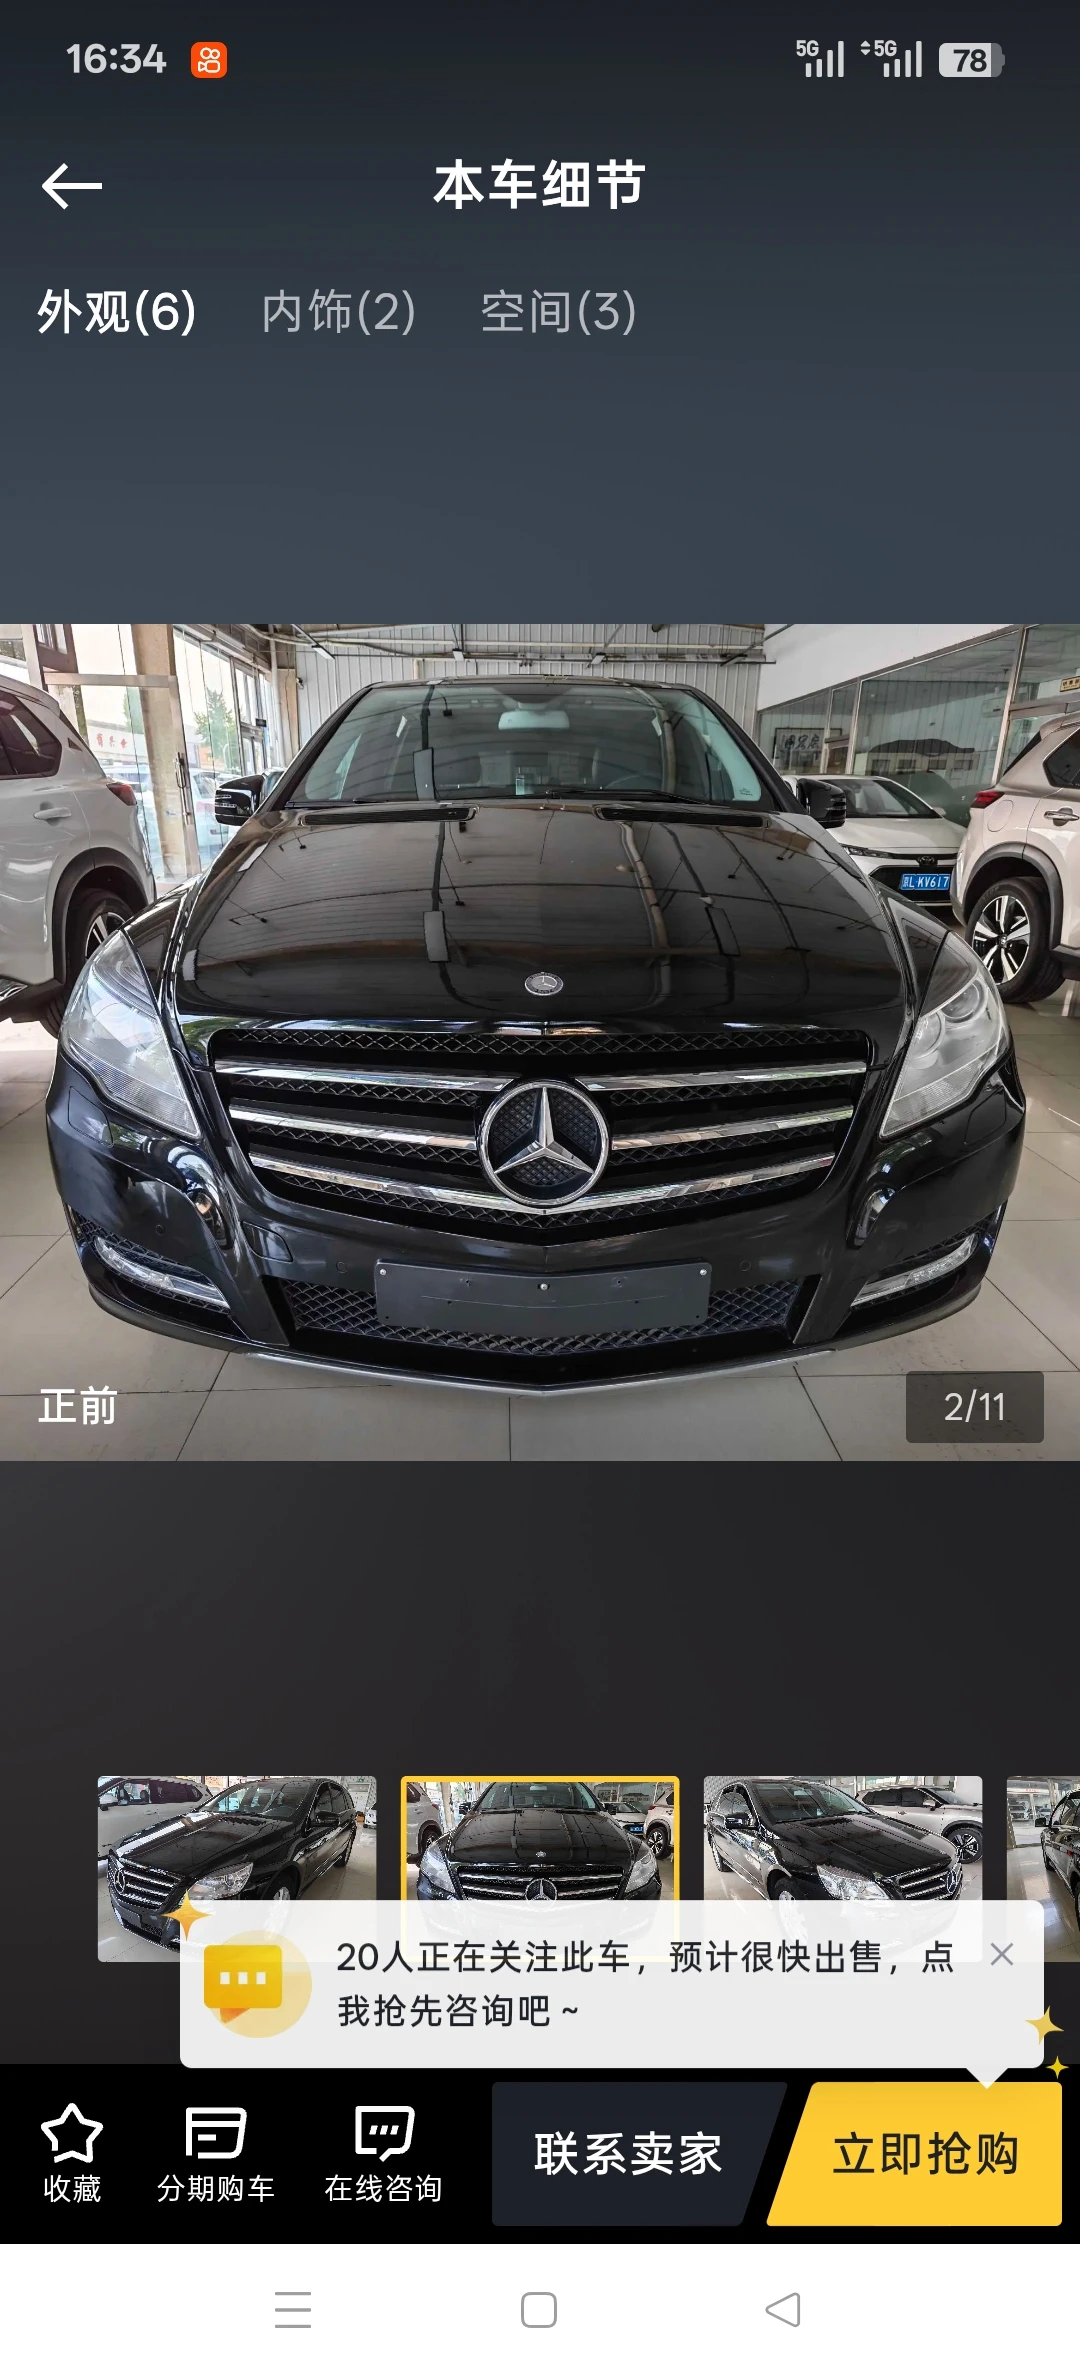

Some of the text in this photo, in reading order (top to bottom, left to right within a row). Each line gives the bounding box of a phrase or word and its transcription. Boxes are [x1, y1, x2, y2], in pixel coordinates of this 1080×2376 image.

[67, 43, 166, 73] 16:34
[797, 40, 819, 56] 5G
[875, 40, 897, 56] 5G
[953, 49, 987, 72] 78
[433, 158, 645, 209] 本车细节
[37, 289, 195, 336] 外观(6)
[263, 289, 415, 336] 内饰(2)
[480, 289, 636, 336] 空间(3)
[337, 1938, 955, 1976] 20人正在关注此车，预计很快出售，点
[534, 2131, 723, 2176] 联系卖家
[832, 2131, 1019, 2176] 立即抢购
[43, 2173, 102, 2204] 收藏
[156, 2173, 275, 2203] 分期购车
[324, 2173, 442, 2203] 在线咨询
